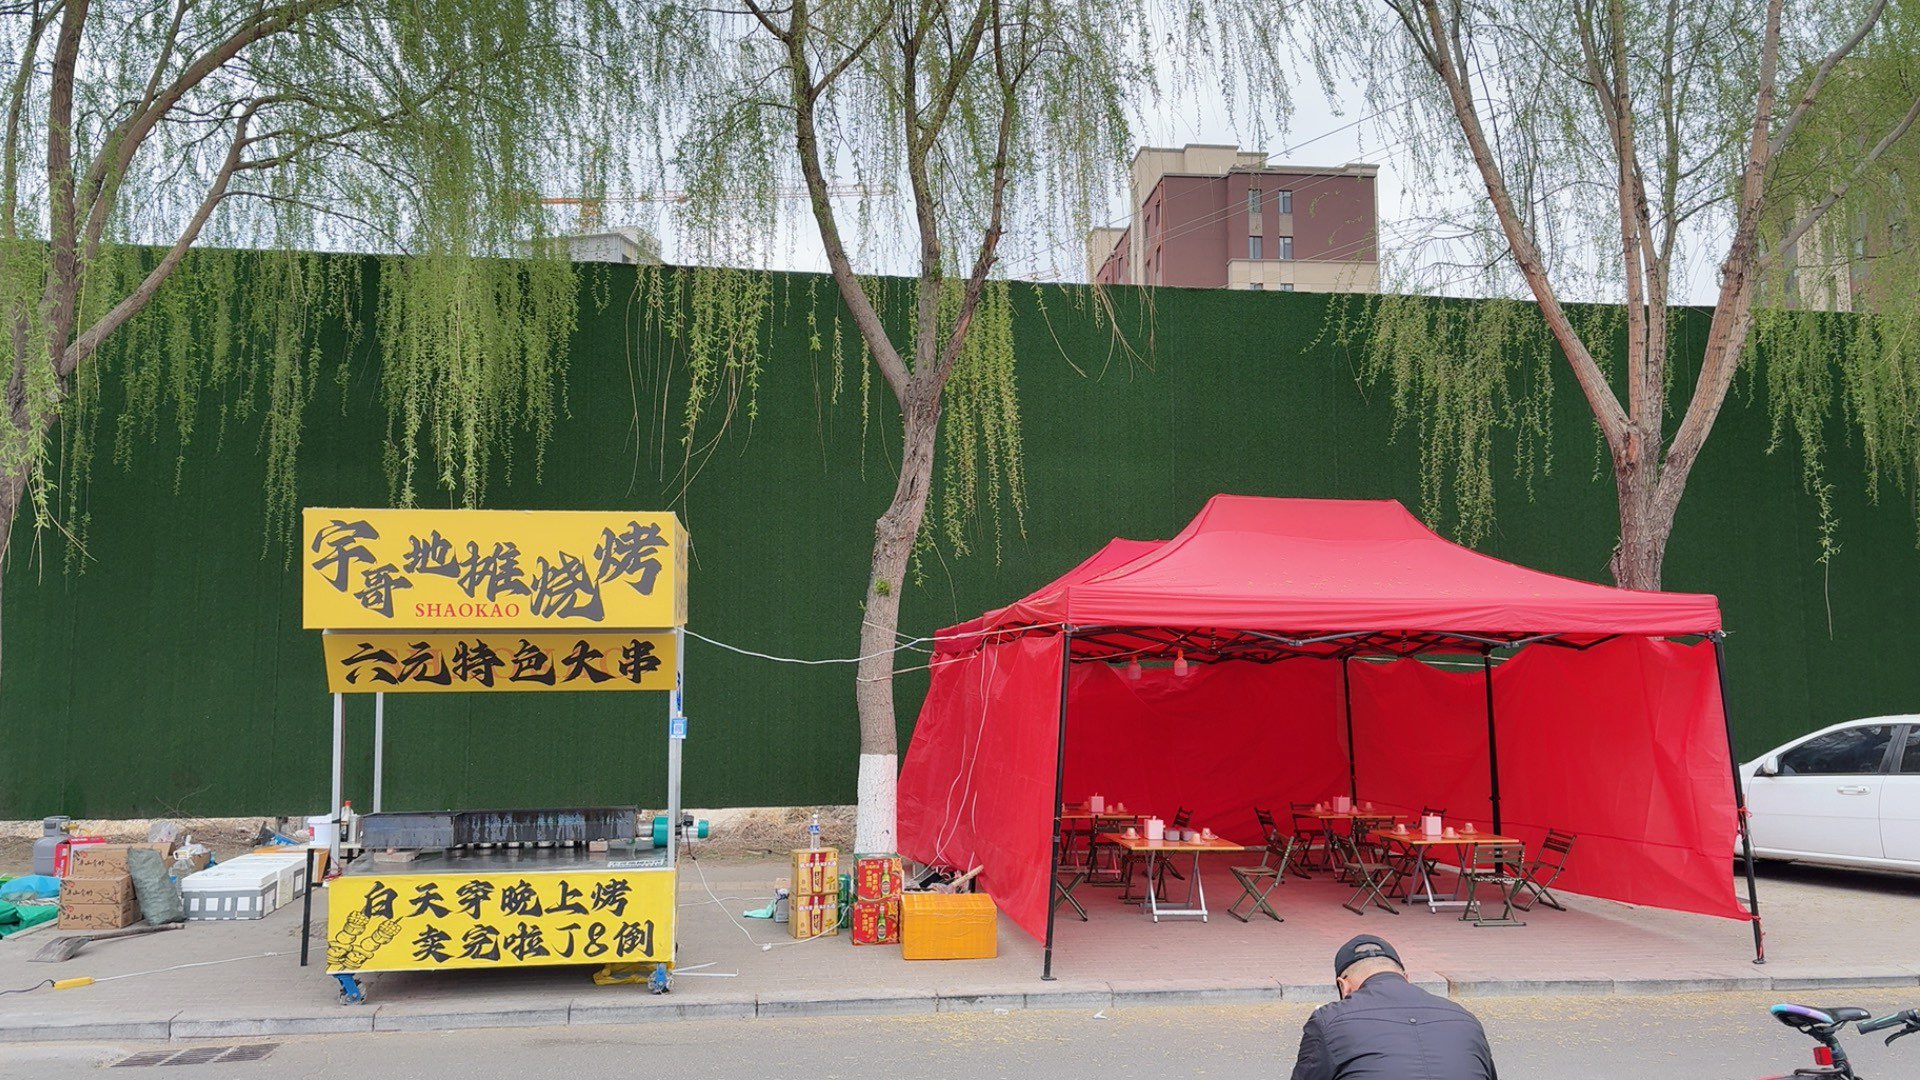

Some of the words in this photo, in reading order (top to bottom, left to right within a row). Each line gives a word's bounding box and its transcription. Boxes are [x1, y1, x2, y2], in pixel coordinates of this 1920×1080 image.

[311, 519, 670, 622] 宇哥地摊烧烤
[415, 602, 520, 619] SHAOKAO
[340, 638, 662, 688] 六元特色大串
[363, 878, 633, 920] 白天穿晚上烤
